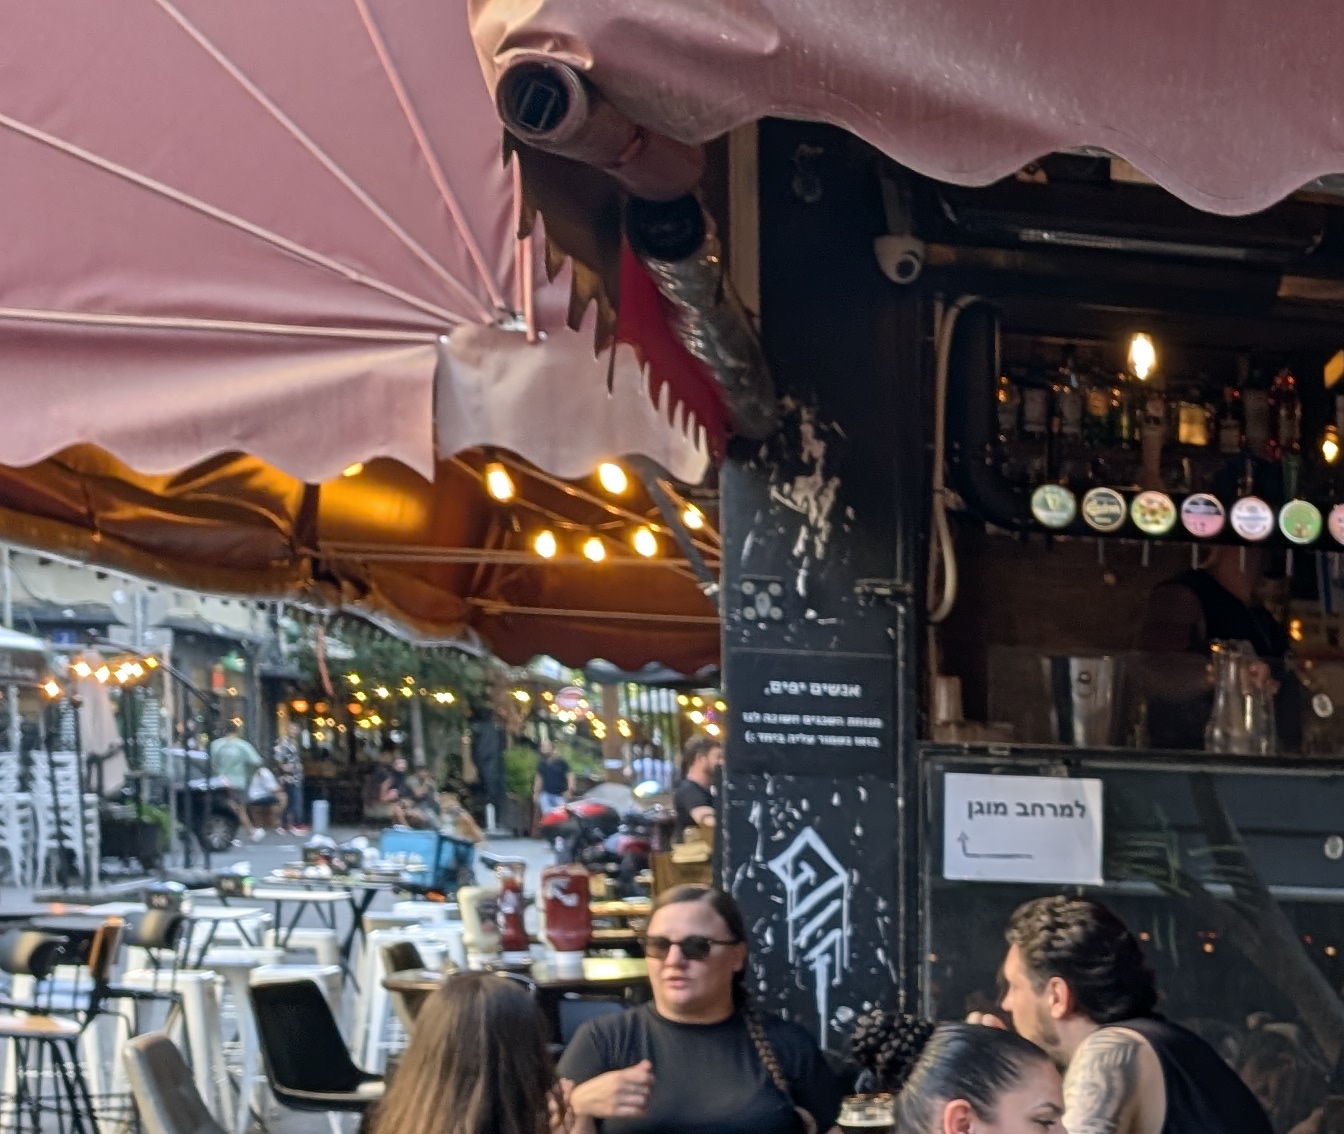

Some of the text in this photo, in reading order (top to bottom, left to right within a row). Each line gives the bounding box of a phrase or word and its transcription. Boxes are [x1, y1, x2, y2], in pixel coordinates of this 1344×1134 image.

[809, 682, 862, 697] אנשים
[967, 800, 1086, 820] למרחב מוגן
